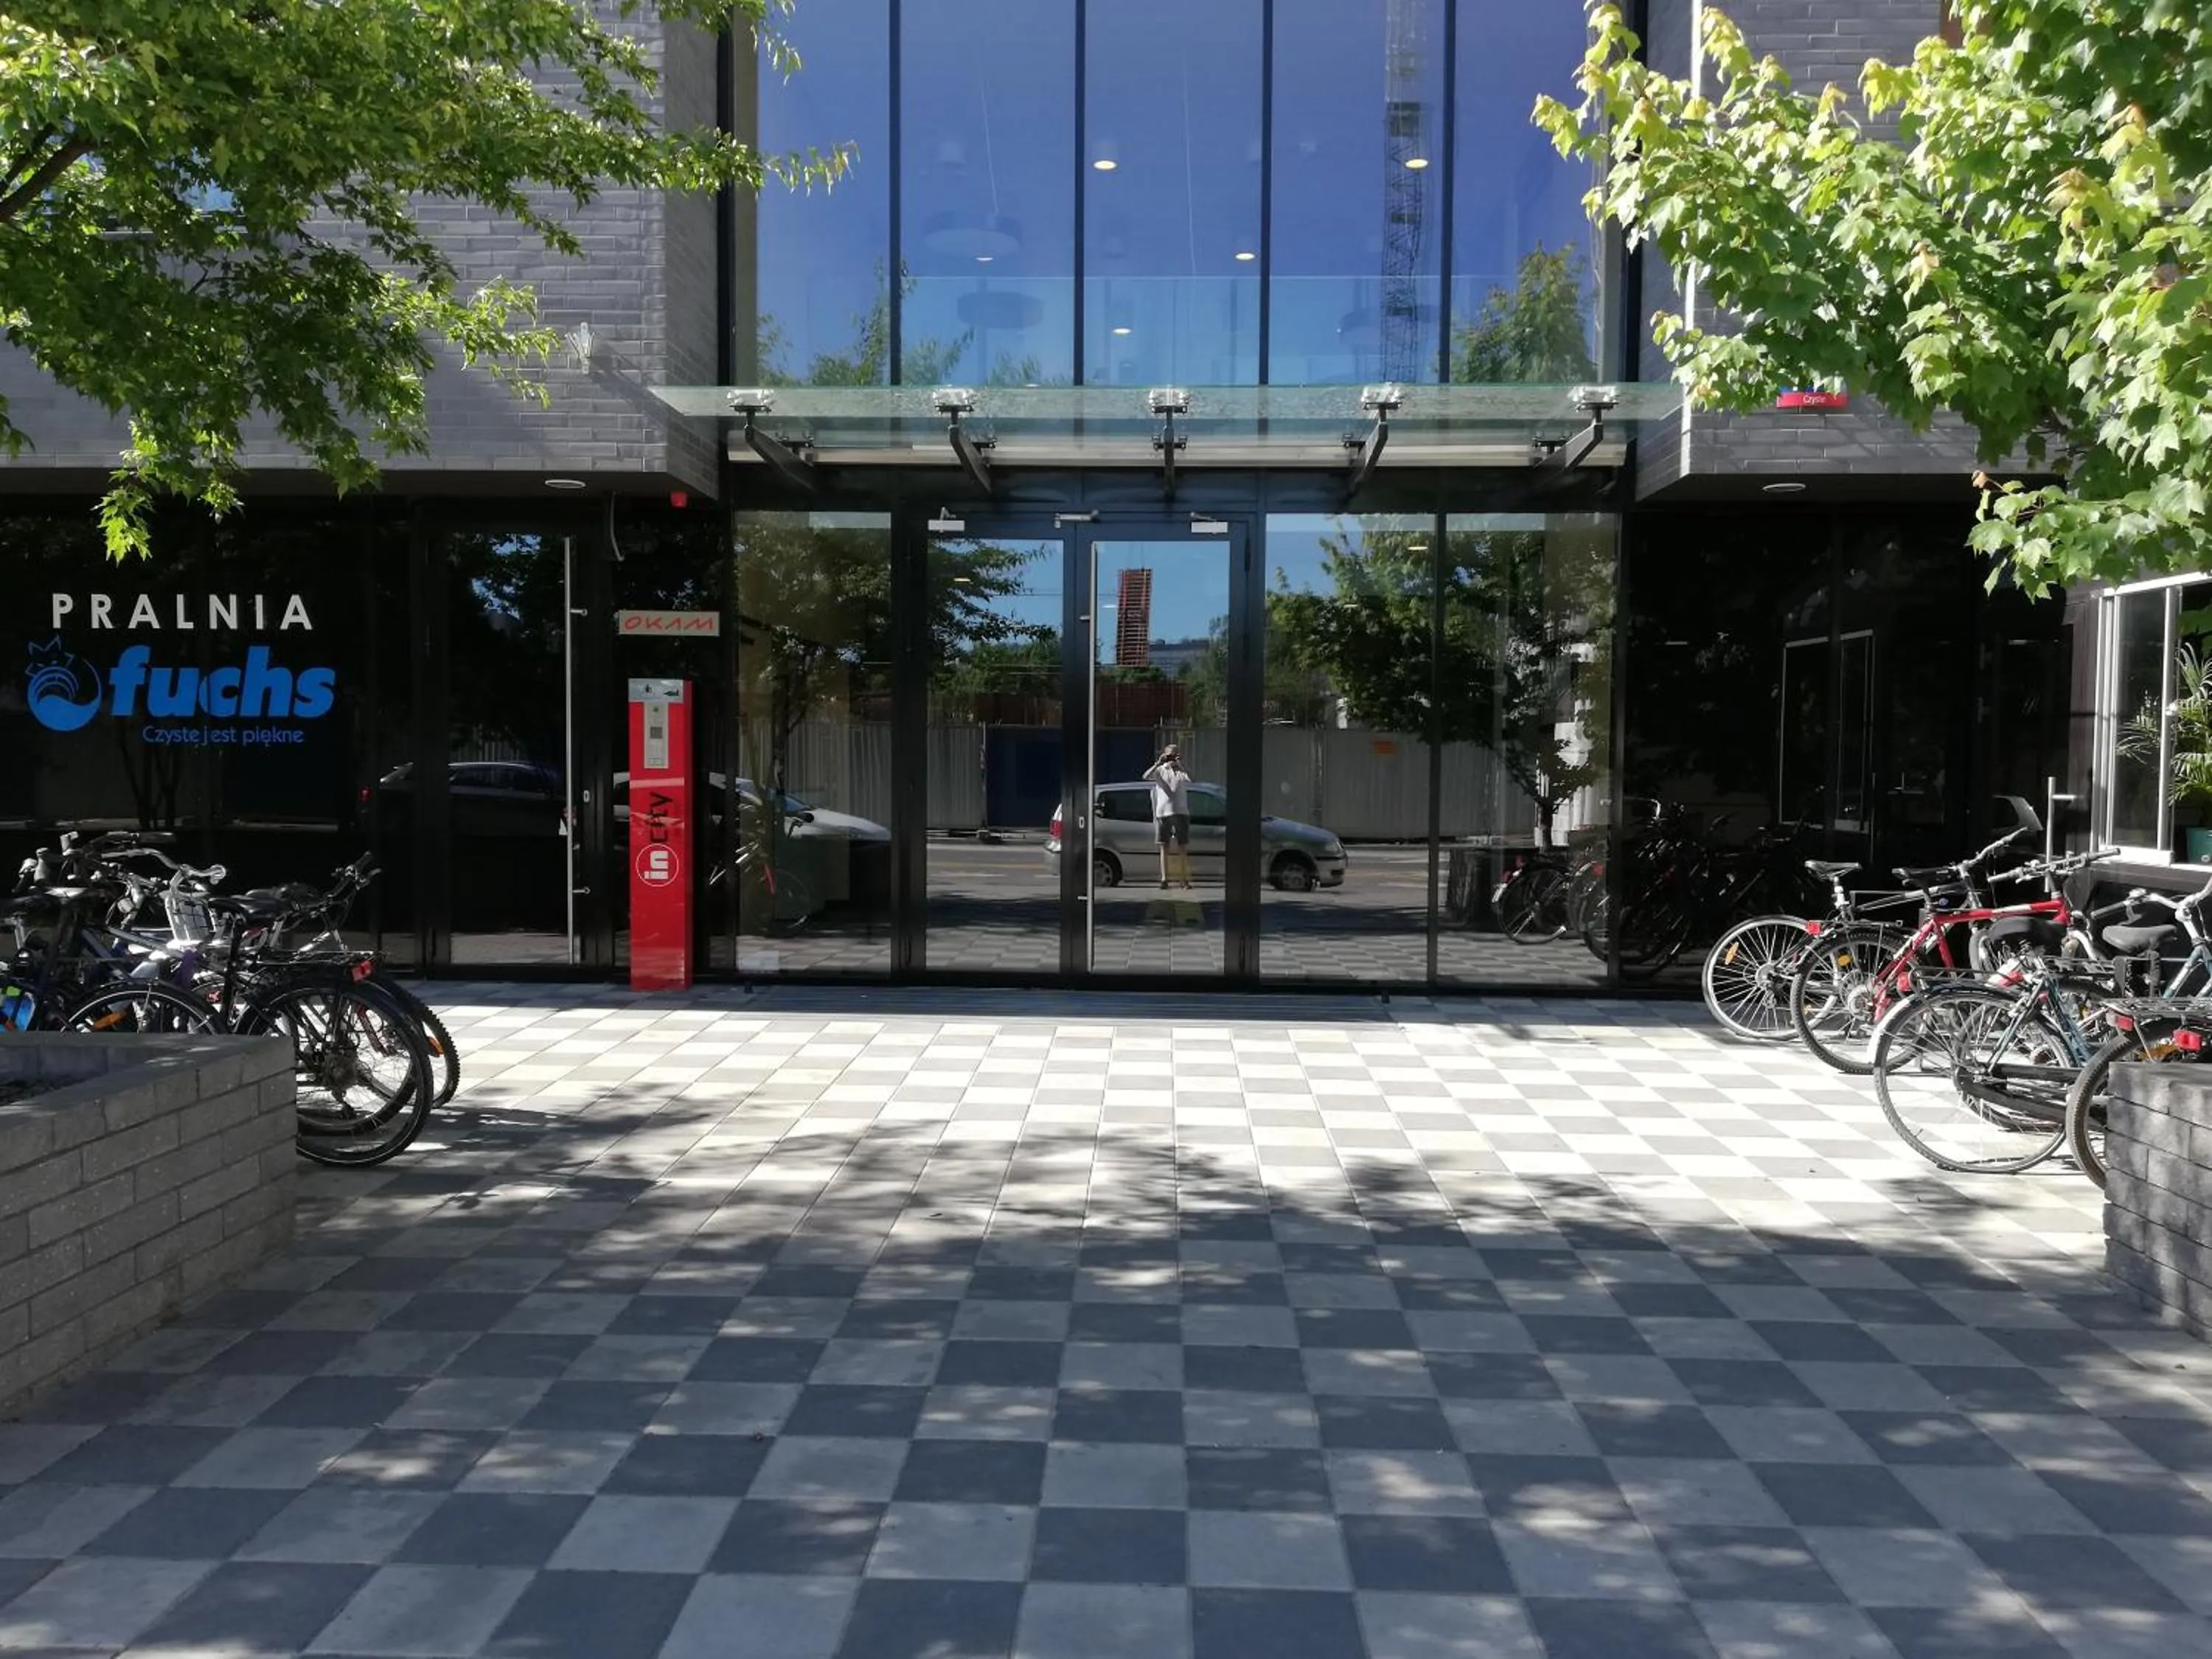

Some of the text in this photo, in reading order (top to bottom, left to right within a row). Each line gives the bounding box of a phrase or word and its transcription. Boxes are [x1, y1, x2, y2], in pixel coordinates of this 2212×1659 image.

[52, 594, 313, 630] PRALNIA
[624, 616, 713, 630] OKAM
[109, 644, 335, 717] fuchs
[142, 725, 305, 747] Czyste jest piękne
